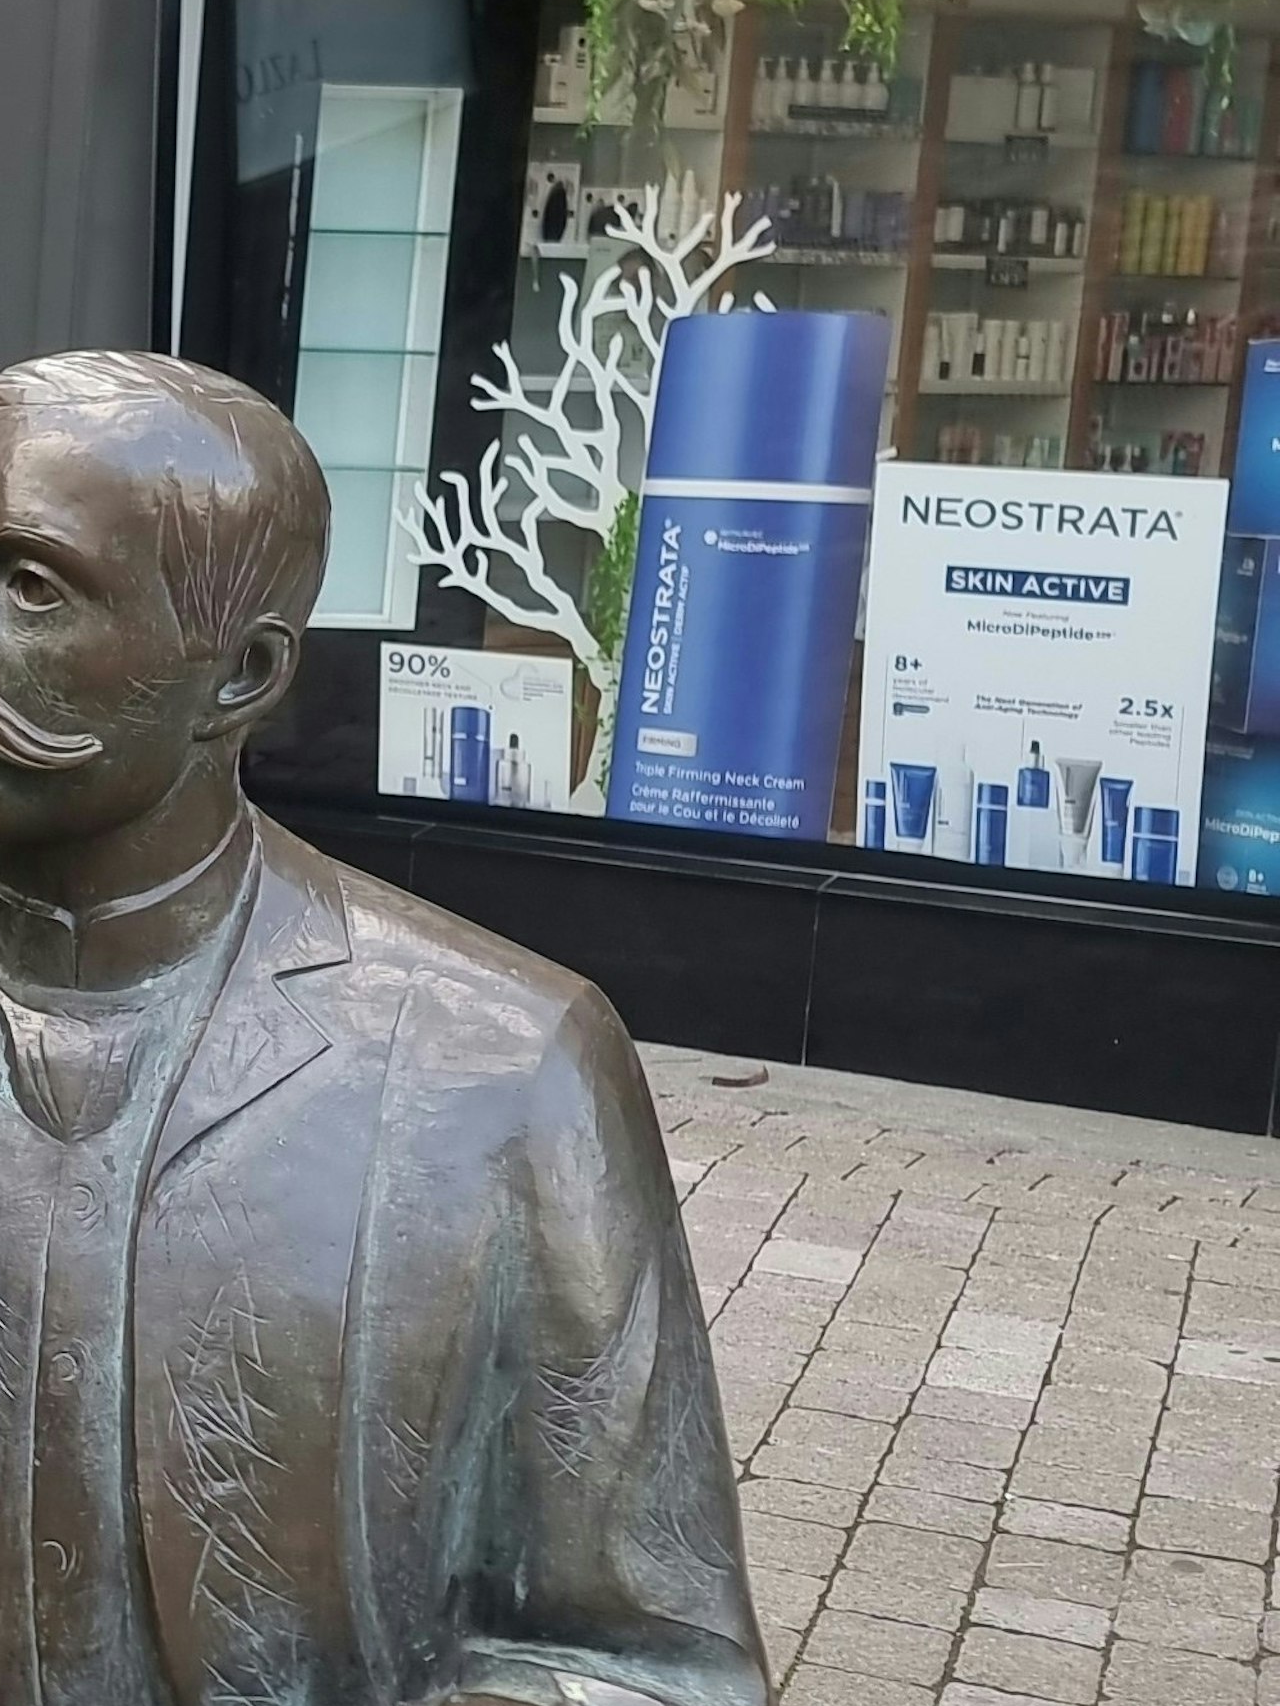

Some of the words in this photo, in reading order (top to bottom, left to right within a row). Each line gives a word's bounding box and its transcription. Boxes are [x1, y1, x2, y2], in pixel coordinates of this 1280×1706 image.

[902, 494, 1181, 542] NEOSTRATA
[950, 568, 1015, 595] SKIN
[1021, 572, 1125, 602] ACTIVE
[640, 524, 682, 715] NEOSTRATA
[388, 651, 451, 679] 90%
[895, 655, 923, 671] 8+
[1118, 697, 1174, 719] 2.5x
[634, 760, 666, 778] Triple
[668, 764, 721, 786] Firming
[725, 770, 760, 788] Neck
[763, 774, 806, 791] Cream
[671, 787, 776, 811] Raffermissante
[673, 803, 701, 820] Cou
